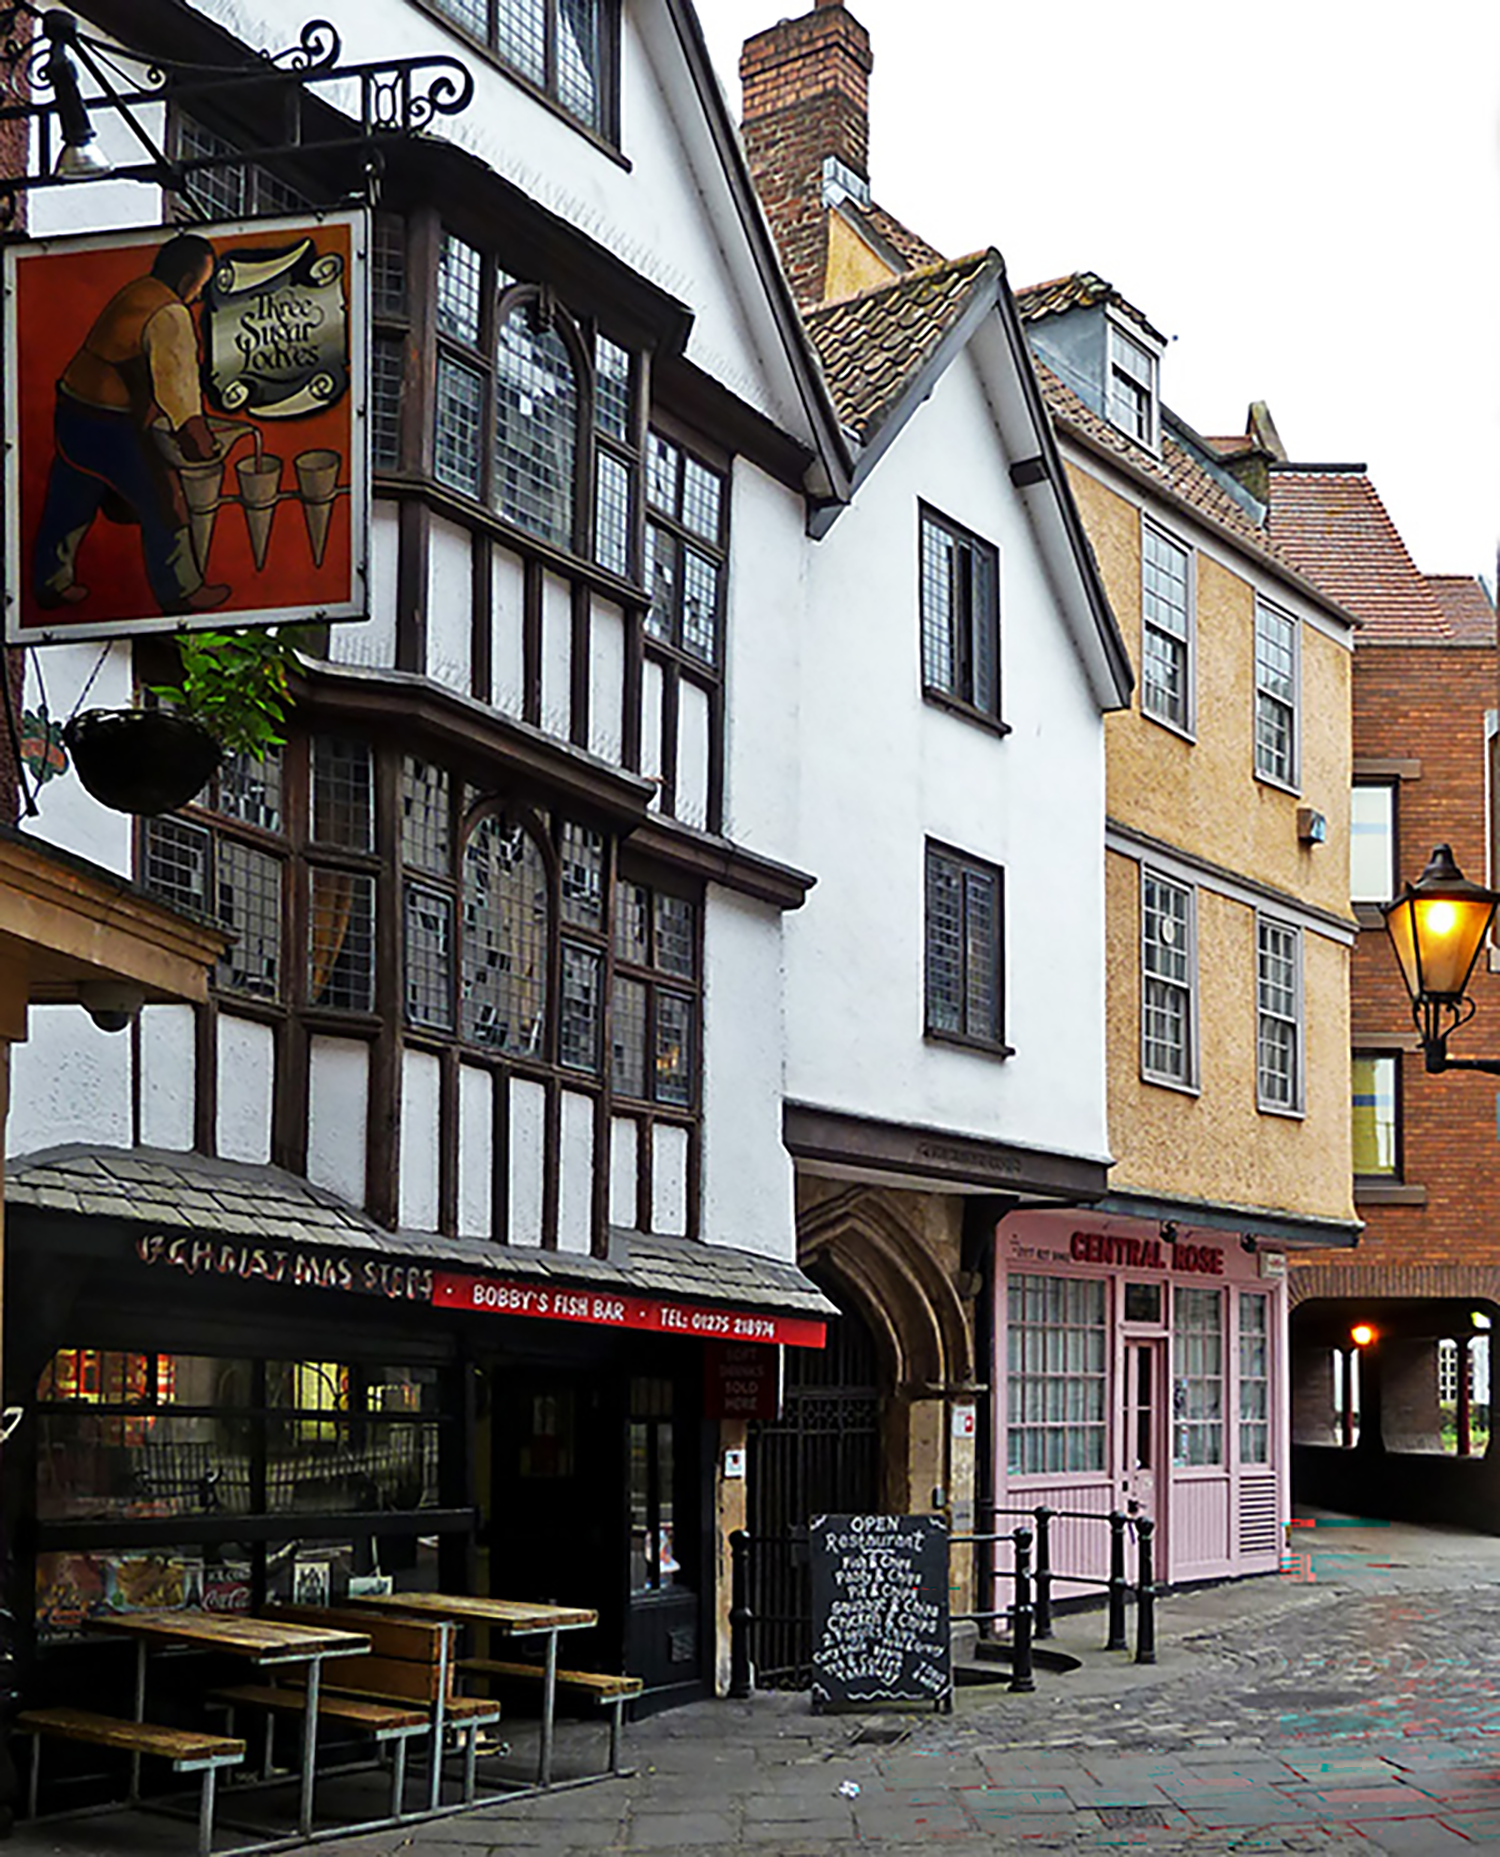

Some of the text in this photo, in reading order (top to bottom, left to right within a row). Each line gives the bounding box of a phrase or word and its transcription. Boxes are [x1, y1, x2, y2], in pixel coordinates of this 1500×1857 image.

[249, 291, 313, 321] Three
[1069, 1231, 1224, 1275] CENTRAL ROSE
[168, 1238, 351, 1290] CHRISTMAS
[363, 1261, 432, 1299] STEPS
[472, 1284, 624, 1321] BOBBY'S FISH BAR
[660, 1307, 688, 1328] TEL:
[724, 1379, 759, 1395] SOLD
[850, 1516, 900, 1533] OPEN
